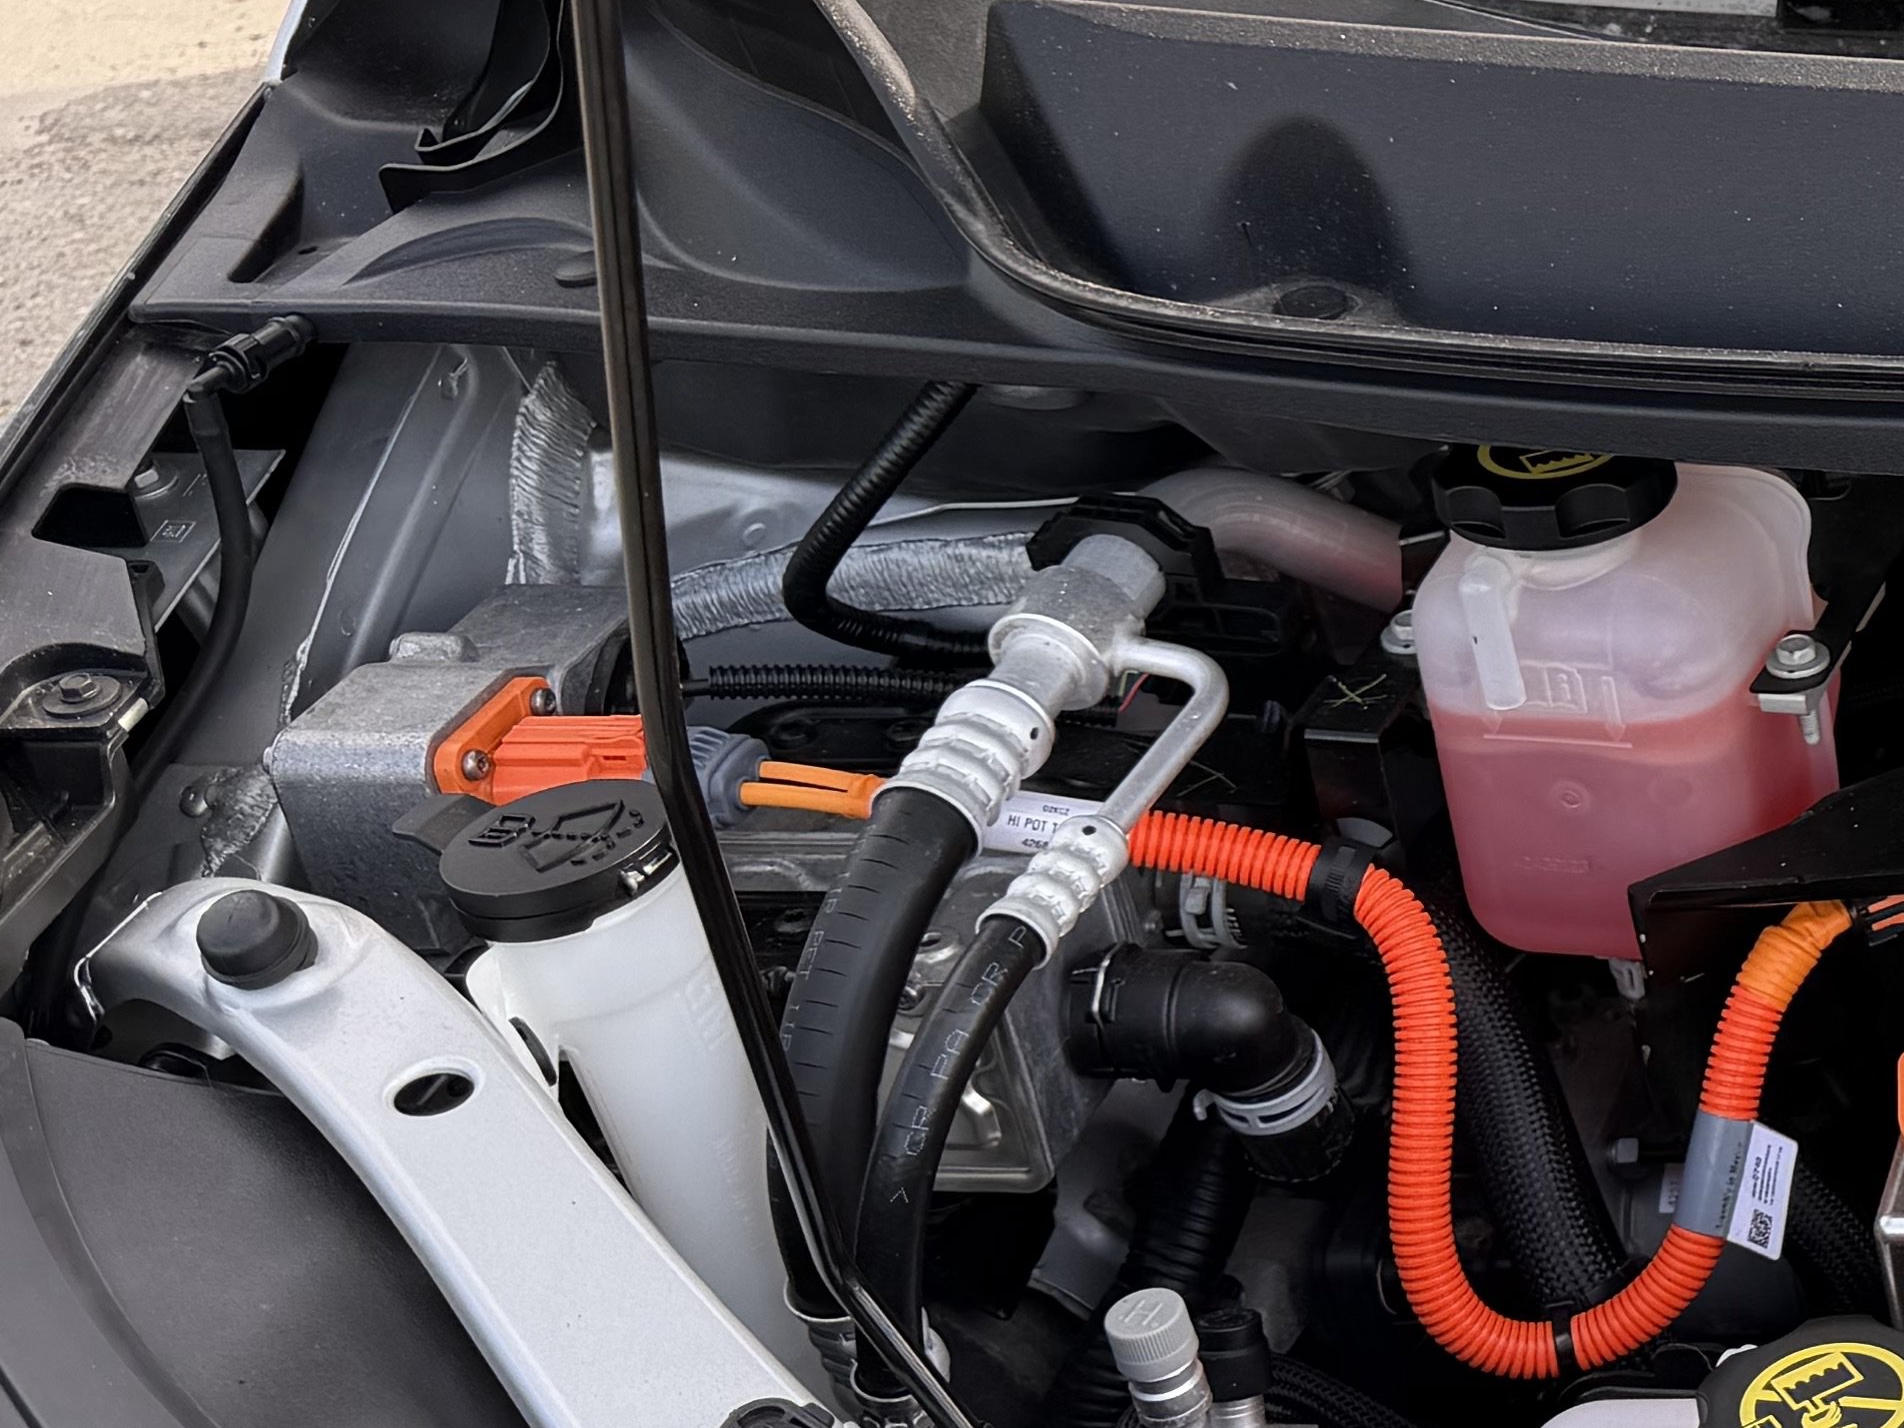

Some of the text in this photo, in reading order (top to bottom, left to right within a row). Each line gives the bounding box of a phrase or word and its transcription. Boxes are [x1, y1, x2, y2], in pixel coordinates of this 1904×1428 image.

[1007, 814, 1021, 827] HI
[1024, 817, 1048, 832] POT
[1124, 1299, 1164, 1326] H
